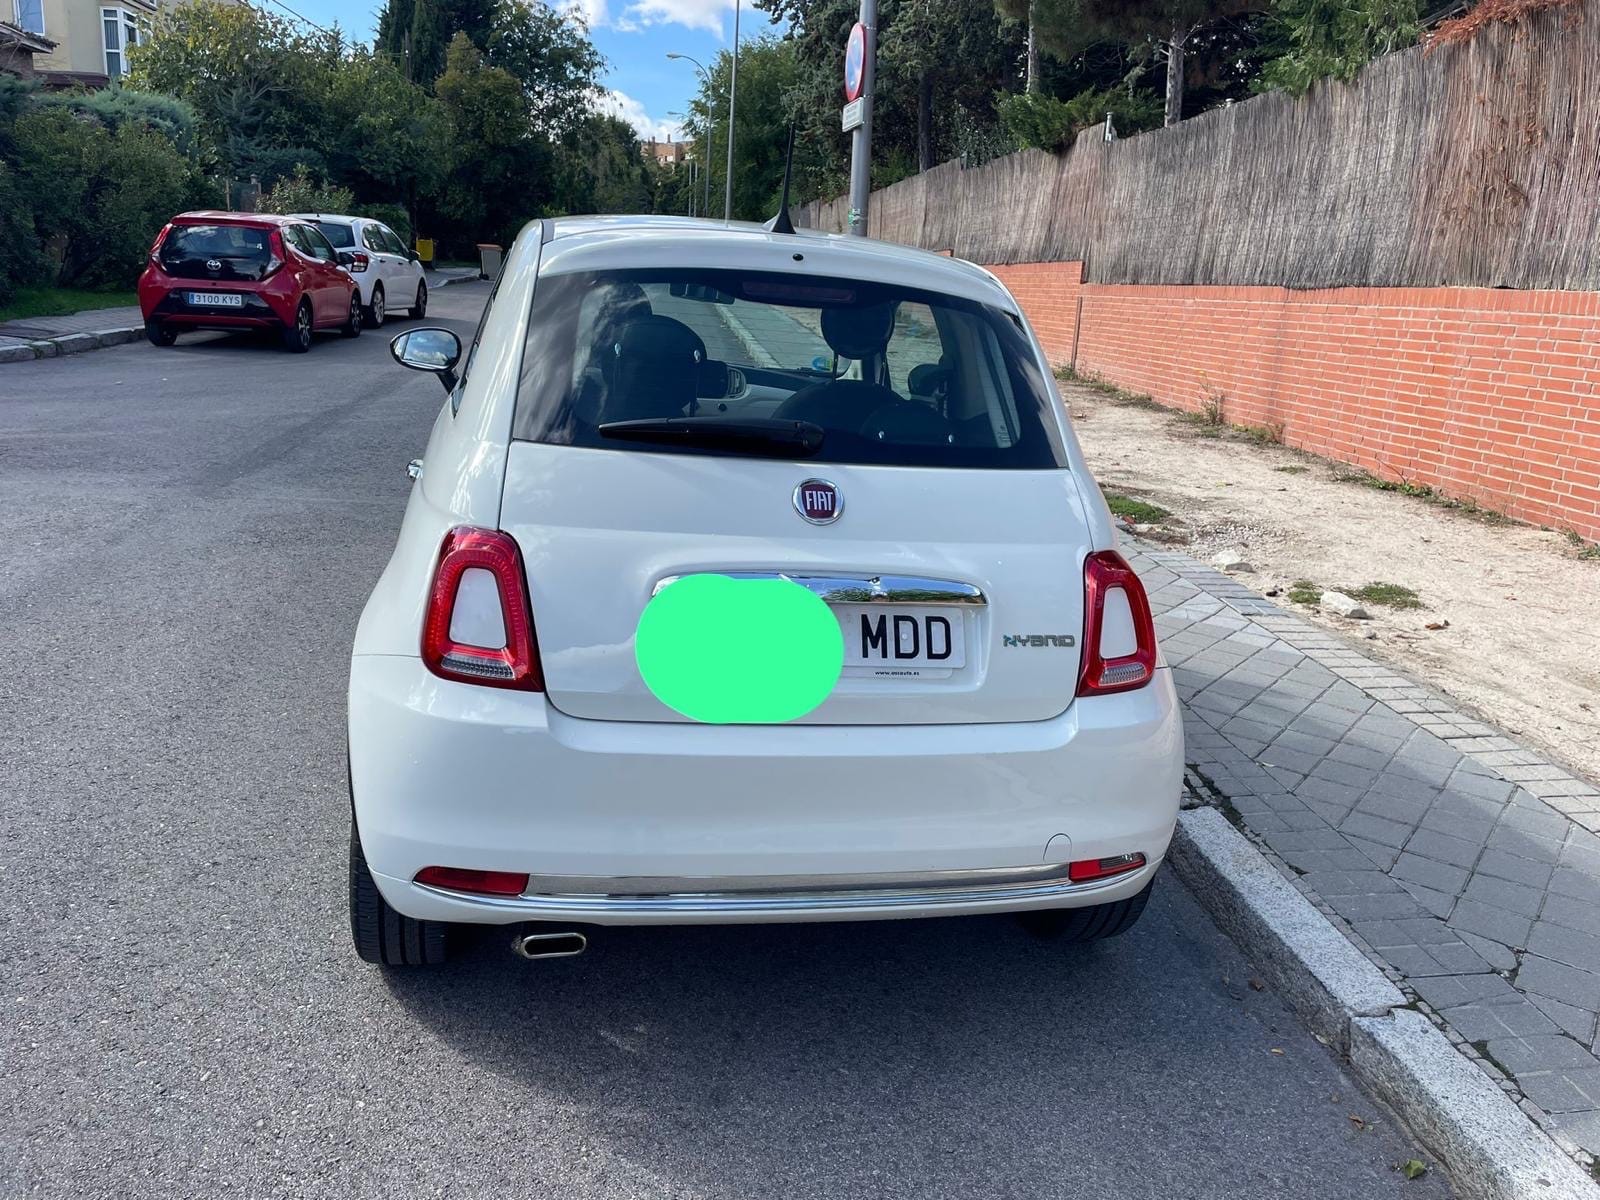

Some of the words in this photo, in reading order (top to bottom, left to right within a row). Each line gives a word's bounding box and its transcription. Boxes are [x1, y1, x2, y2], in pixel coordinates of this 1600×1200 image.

[195, 294, 220, 304] 3100
[221, 295, 241, 305] KYS
[805, 490, 834, 511] FIAT
[861, 614, 952, 660] MDD
[1002, 634, 1076, 648] HYBRID
